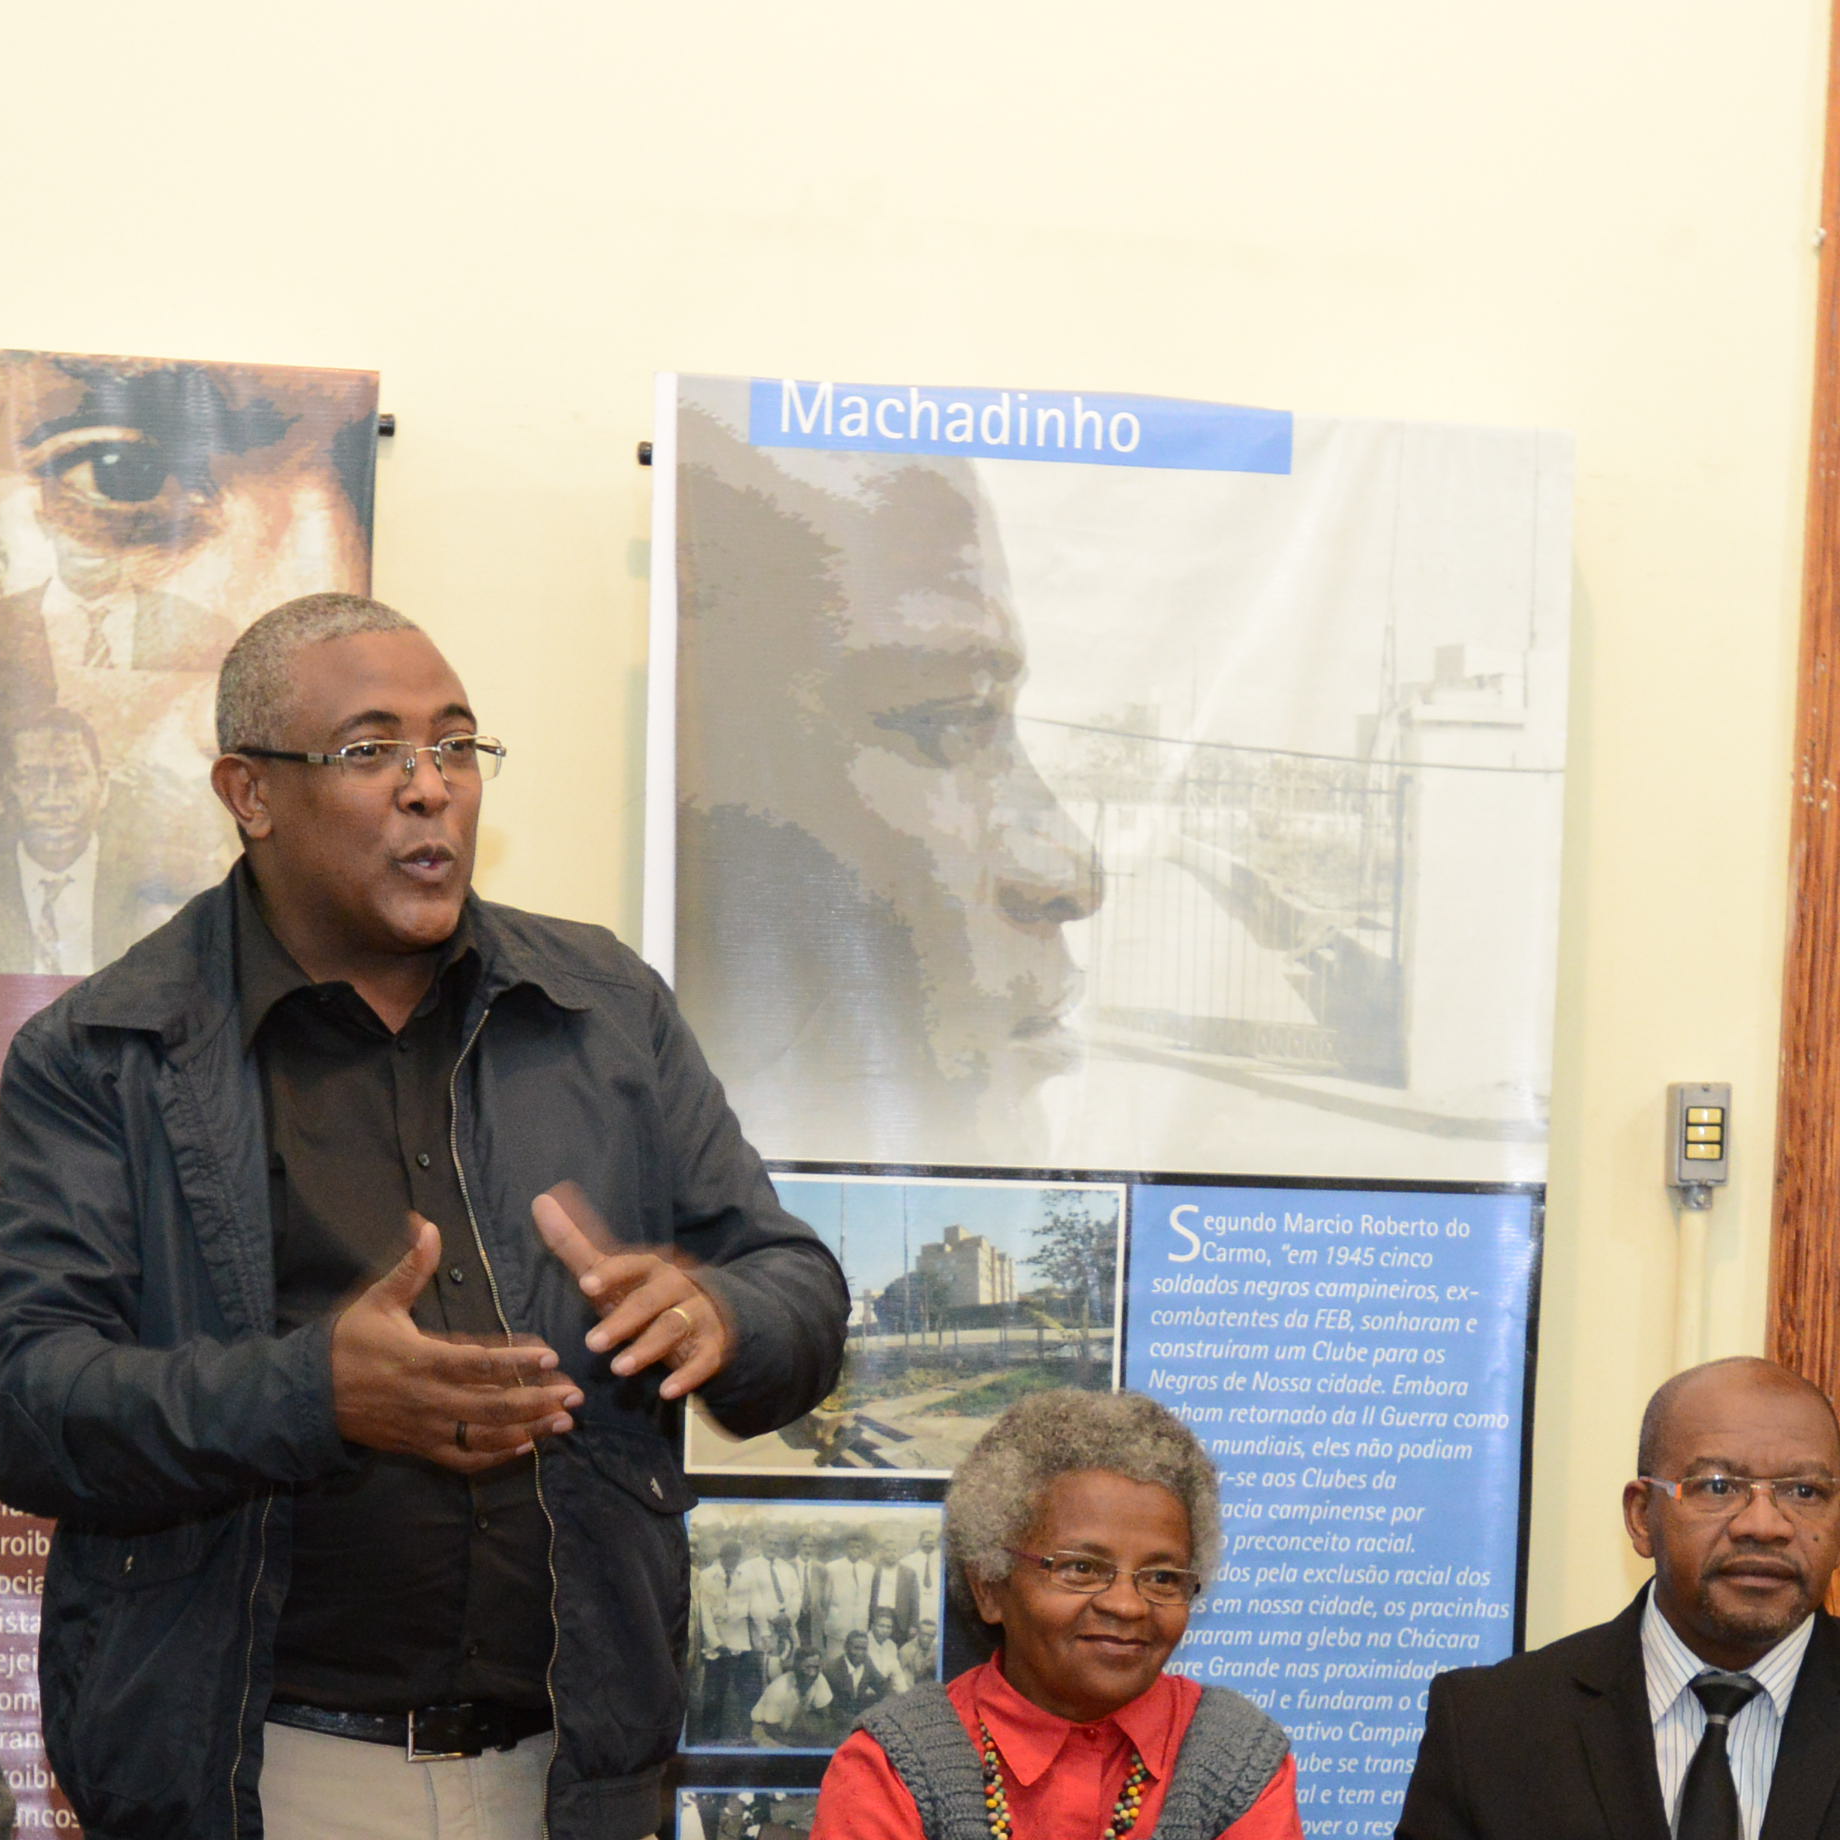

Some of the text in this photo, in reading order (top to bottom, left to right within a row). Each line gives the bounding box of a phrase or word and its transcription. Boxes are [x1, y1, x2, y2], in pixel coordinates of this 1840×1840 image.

[779, 378, 1142, 455] Machadinho
[1284, 1213, 1353, 1235] Marcio
[1360, 1216, 1438, 1237] Roberto
[1446, 1219, 1470, 1237] do
[1202, 1241, 1271, 1267] Carmo,
[1327, 1246, 1374, 1267] 1945
[1380, 1249, 1433, 1268] cinco
[1151, 1274, 1479, 1306] soldados negros campineiros, ex-
[1151, 1307, 1478, 1333] combatentes da FEB, sonharam e
[1275, 1344, 1306, 1361] um
[1312, 1342, 1368, 1362] Clube
[1372, 1346, 1418, 1367] para
[1423, 1349, 1446, 1364] os
[1149, 1370, 1469, 1396] Negros de Nossa cidade. Embora
[1228, 1405, 1327, 1426] retornado
[1332, 1406, 1357, 1426] da
[1380, 1409, 1448, 1429] Guerra
[1453, 1413, 1509, 1429] como
[1212, 1434, 1472, 1463] mundiais, eles não podiam
[1262, 1472, 1297, 1488] aos
[1302, 1468, 1367, 1489] Clubes
[1372, 1471, 1396, 1490] da
[1269, 1499, 1386, 1523] campinense
[1391, 1505, 1424, 1526] por
[1233, 1531, 1415, 1555] preconceito racial.
[1255, 1564, 1298, 1585] pela
[1303, 1562, 1390, 1585] exclusão
[1394, 1565, 1452, 1586] racial
[1456, 1566, 1491, 1586] dos
[1212, 1601, 1241, 1614] em
[1247, 1601, 1303, 1615] nossa
[1309, 1596, 1377, 1618] cidade,
[1384, 1603, 1406, 1617] os
[1410, 1597, 1510, 1621] pracinhas
[1258, 1632, 1301, 1646] uma
[1306, 1626, 1361, 1651] gleba
[1368, 1633, 1391, 1648] na
[1397, 1626, 1480, 1649] Chácara
[1209, 1656, 1281, 1678] Grande
[1286, 1662, 1319, 1679] nas
[1280, 1693, 1292, 1709] e
[1297, 1690, 1393, 1711] fundaram
[1399, 1695, 1411, 1711] o
[1337, 1759, 1359, 1773] se
[1321, 1789, 1332, 1804] e
[1338, 1787, 1375, 1805] tem
[1346, 1821, 1358, 1836] o
